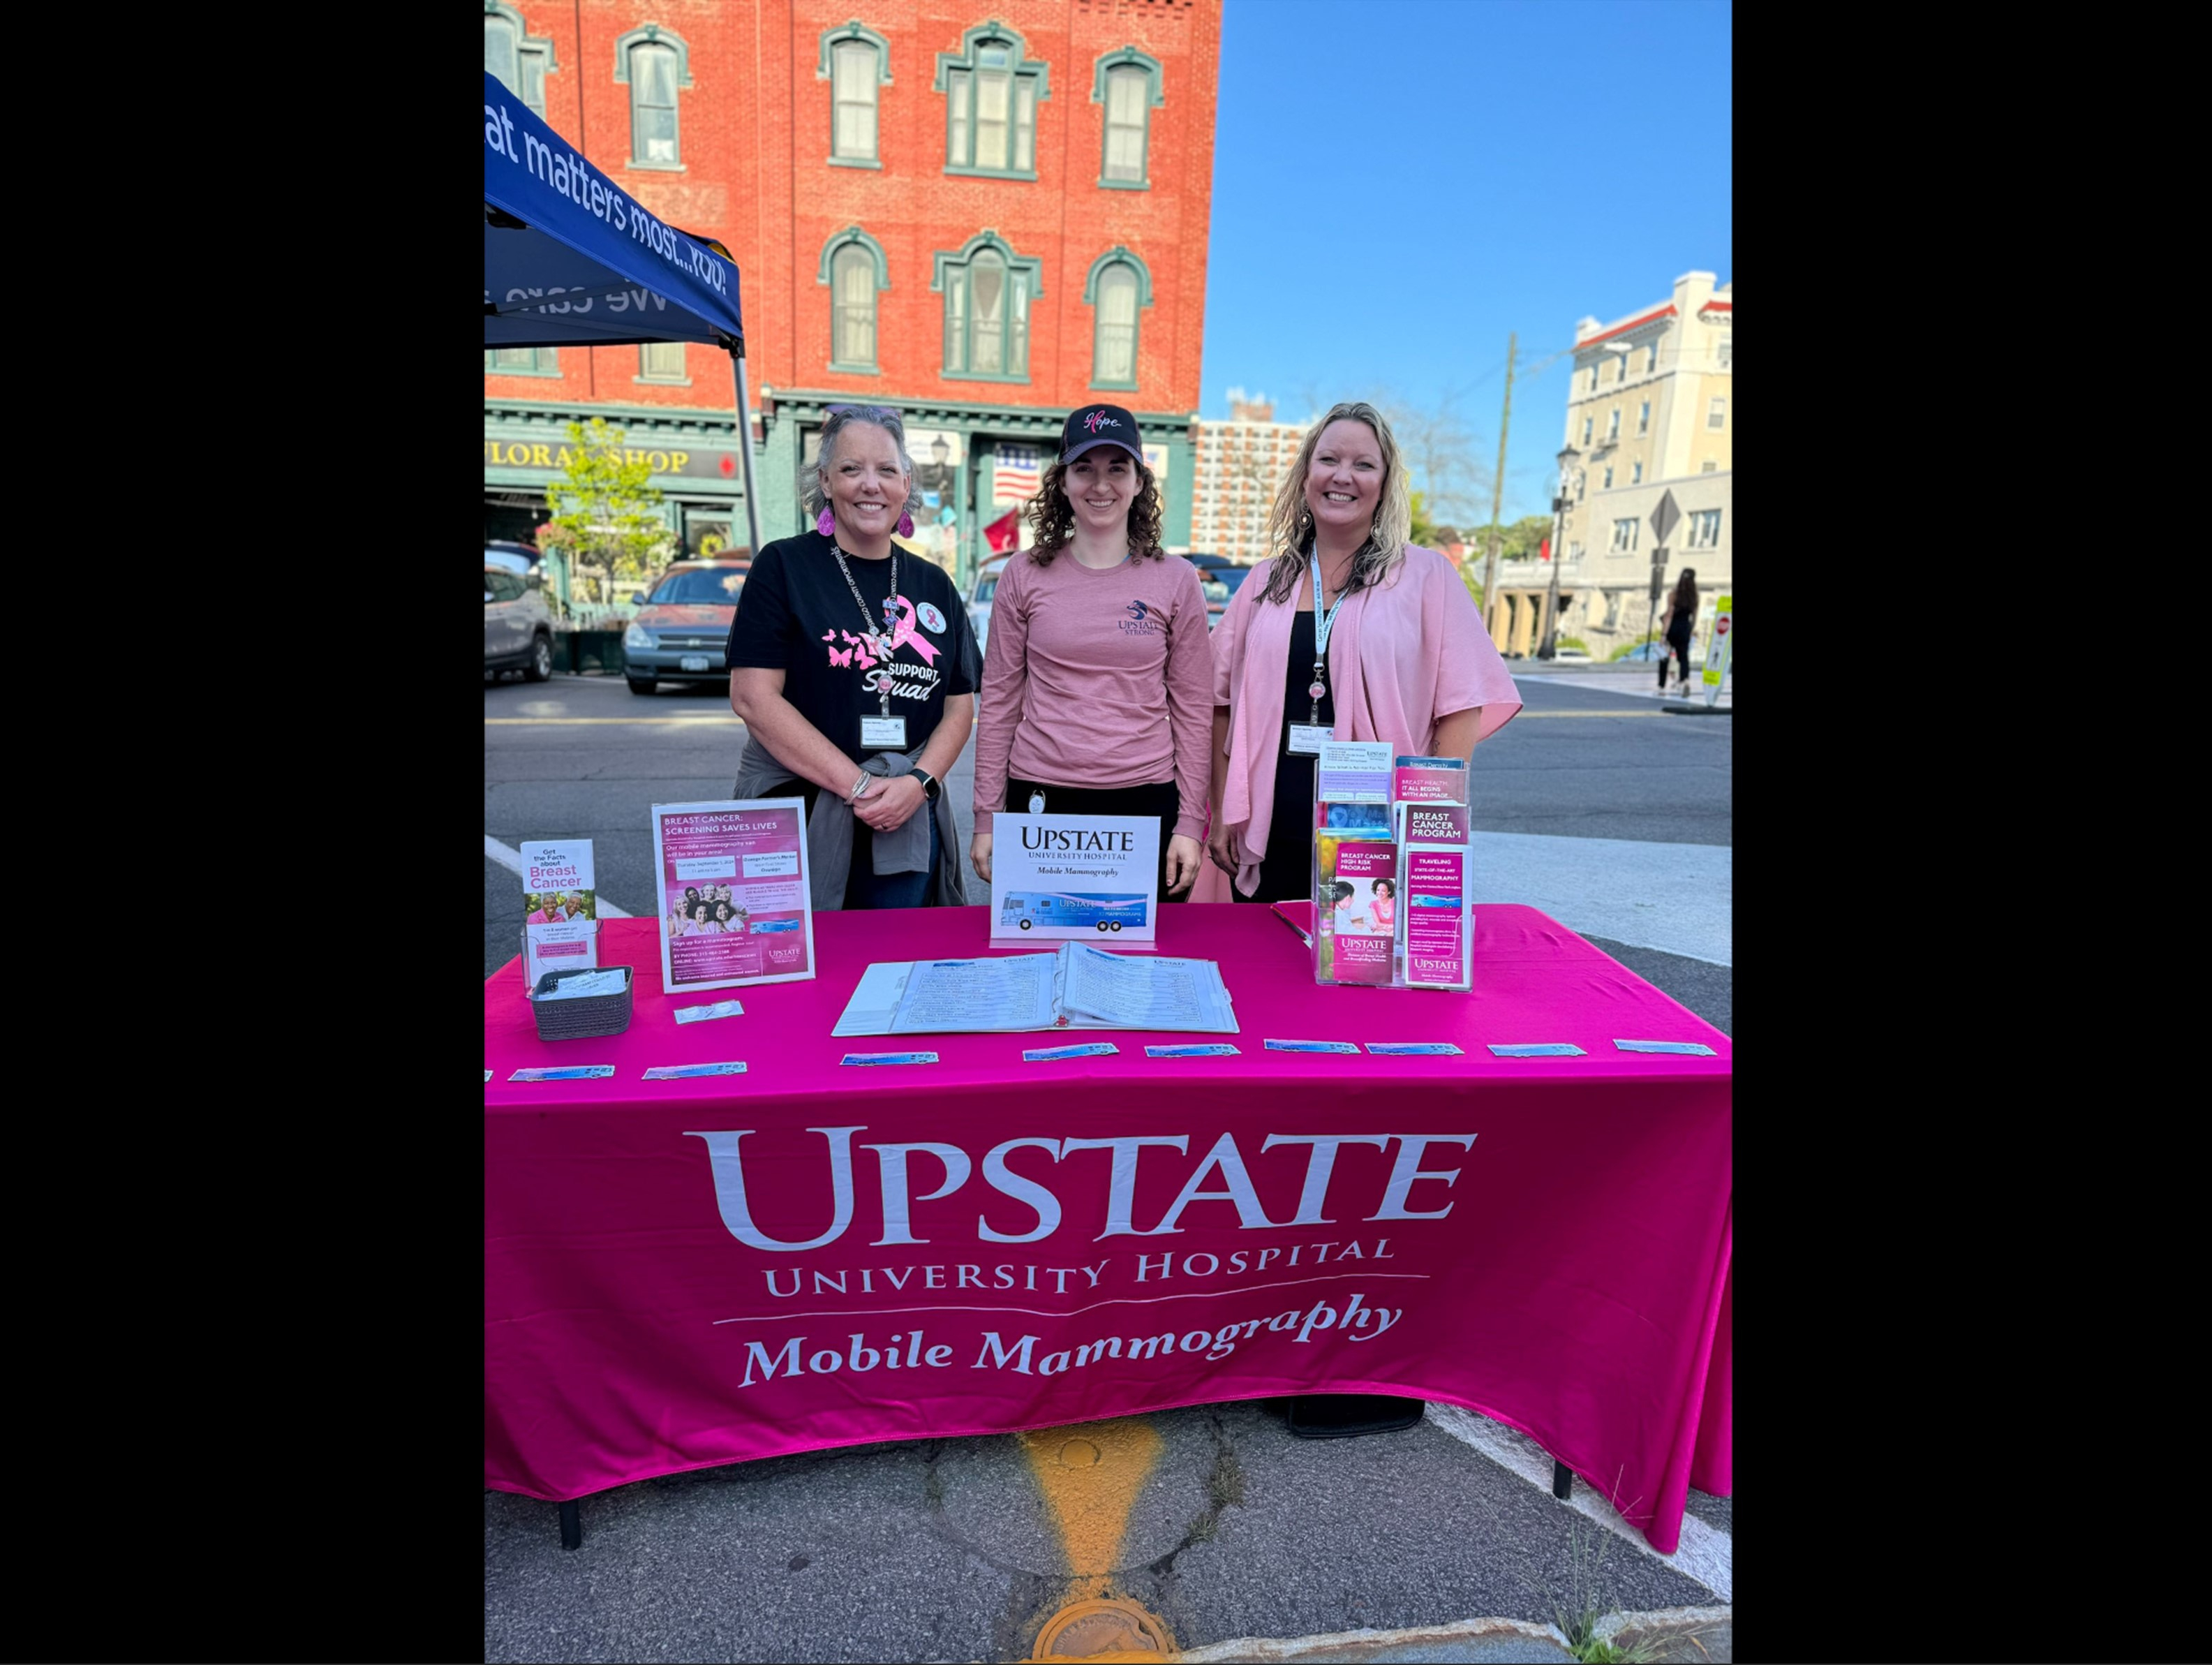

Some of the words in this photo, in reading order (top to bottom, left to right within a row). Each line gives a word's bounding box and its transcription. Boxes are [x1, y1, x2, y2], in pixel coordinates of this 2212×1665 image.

[524, 130, 627, 232] matters
[630, 203, 727, 296] most...you!
[1083, 410, 1122, 434] Hope
[1118, 620, 1157, 629] UPSTATE
[889, 663, 938, 682] SUPPORT
[862, 669, 941, 702] Suad
[665, 816, 699, 825] BREAST
[701, 815, 743, 824] CANCER:
[1413, 812, 1450, 821] BREAST
[665, 826, 720, 836] SCREENING
[722, 824, 750, 832] SAVES
[1412, 820, 1454, 830] CANCER
[1019, 826, 1134, 852] UPSTATE
[1411, 829, 1461, 838] PROGRAM
[1028, 852, 1083, 860] UNIVERSITY
[1083, 852, 1127, 861] HOSPITAL
[530, 864, 577, 878] Breast
[1037, 866, 1063, 875] Mobile
[1064, 867, 1119, 878] Mammography
[530, 878, 581, 889] Cancer
[1342, 938, 1387, 949] UPSTATE
[769, 949, 801, 957] UPSTATE
[1414, 959, 1459, 970] UPSTATE
[683, 1125, 1478, 1252] UPSTATE
[761, 1259, 1111, 1297] UNIVERSITY
[1134, 1238, 1395, 1282] HOSPITAL
[738, 1330, 953, 1388] Mobile
[970, 1294, 1402, 1376] Mammography
